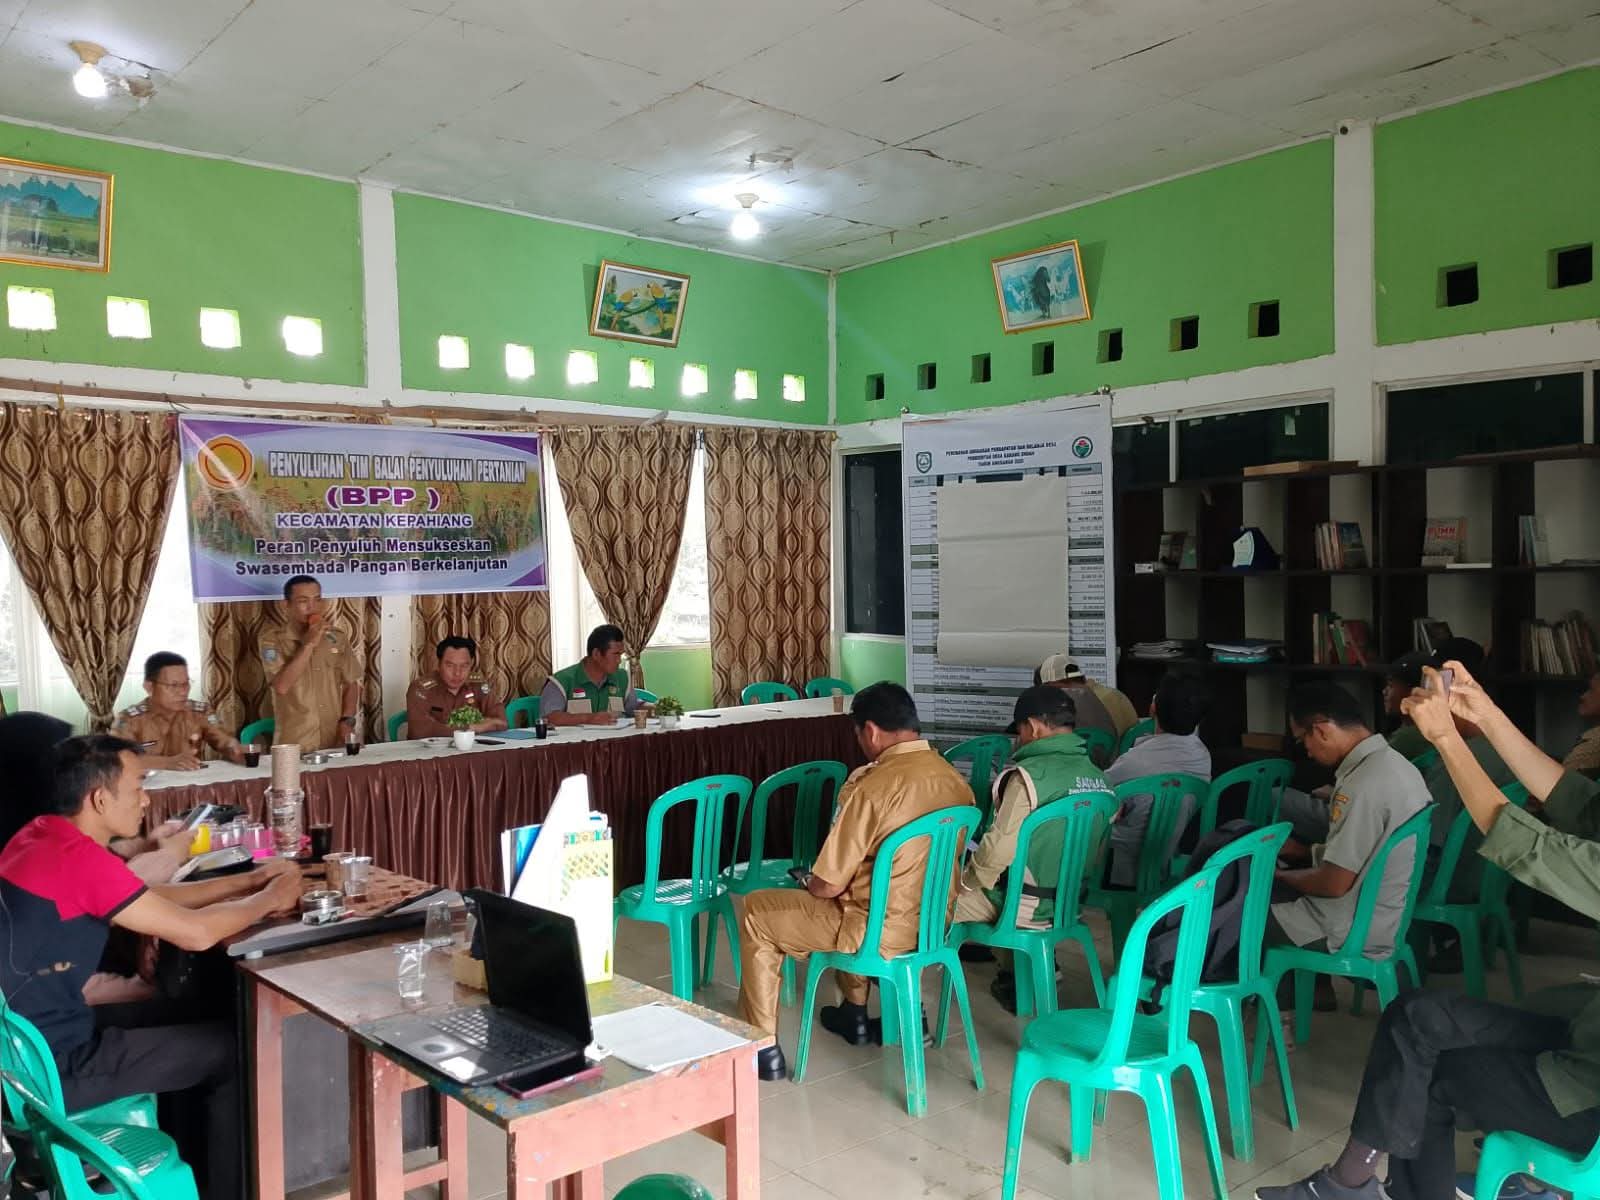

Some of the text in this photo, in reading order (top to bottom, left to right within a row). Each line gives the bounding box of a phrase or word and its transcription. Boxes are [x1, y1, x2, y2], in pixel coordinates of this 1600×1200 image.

[269, 451, 527, 483] PENYULUHAN TIM BALAI PENYULUHAN PERTANIAN
[277, 513, 473, 529] KECAMATAN KEPAHIANG
[256, 538, 491, 557] Peran Penyuluh Mensukseskan
[236, 557, 508, 576] Swasembada Pangan Berkelanjutan
